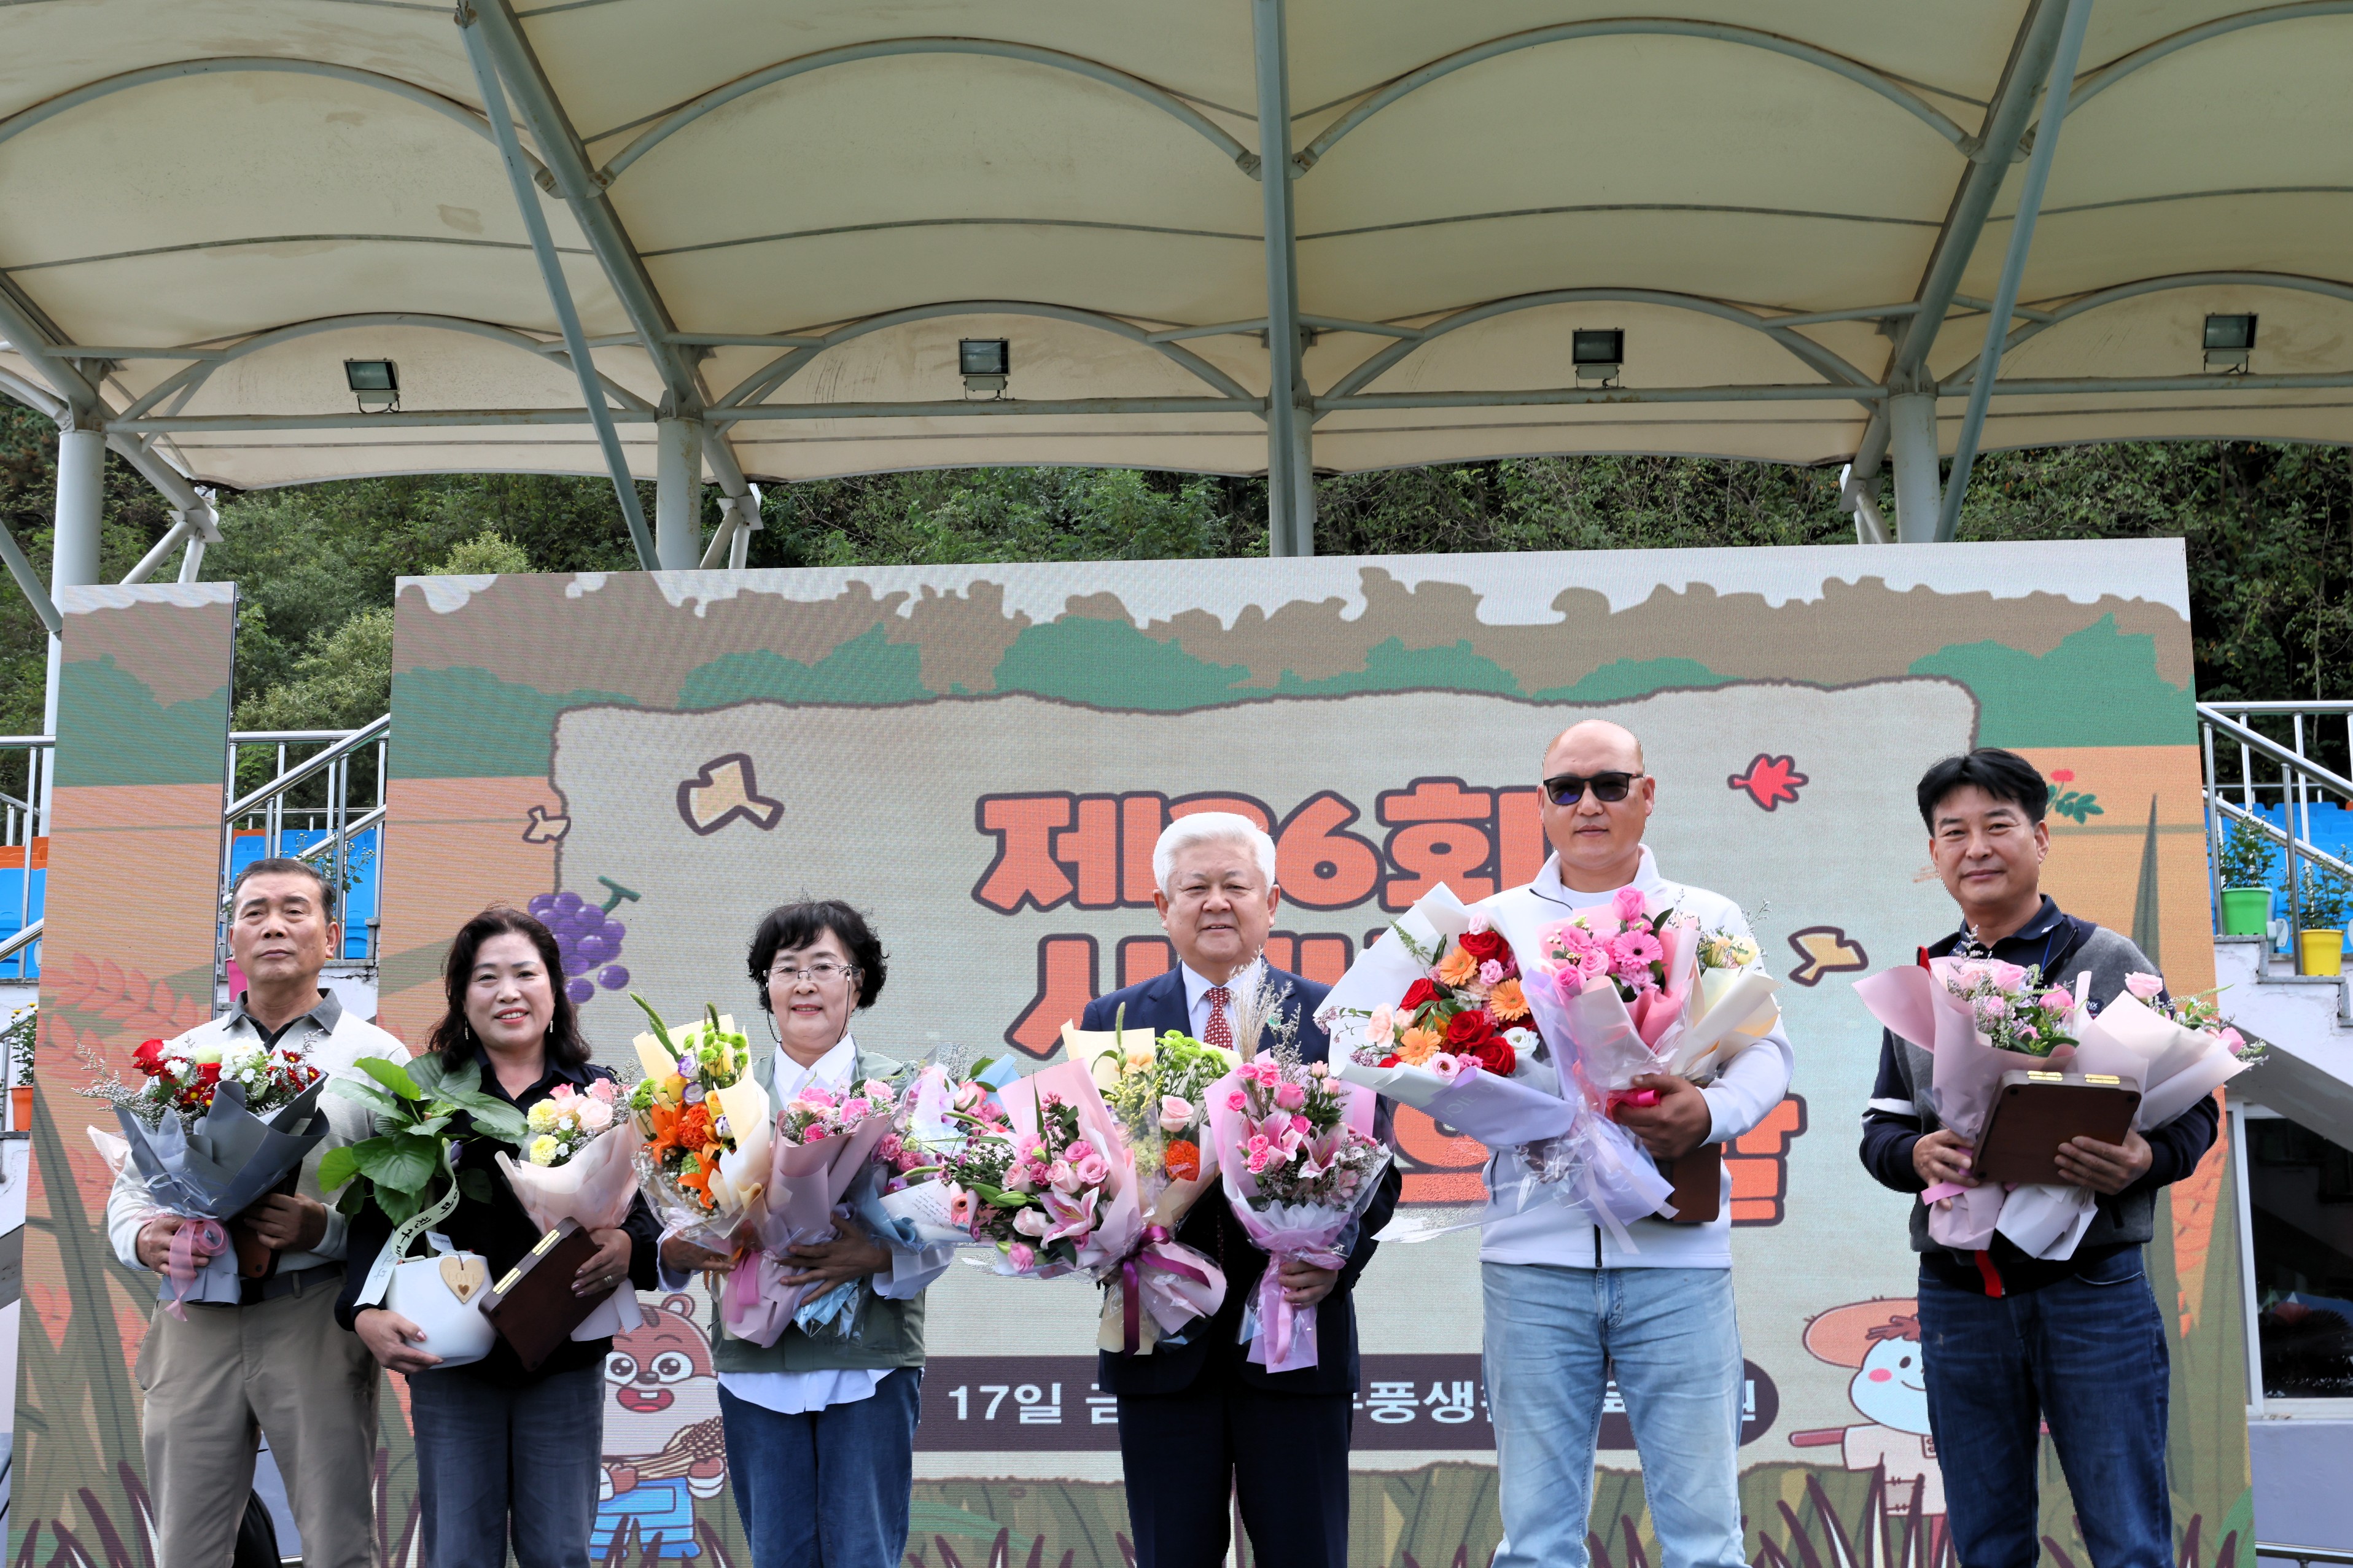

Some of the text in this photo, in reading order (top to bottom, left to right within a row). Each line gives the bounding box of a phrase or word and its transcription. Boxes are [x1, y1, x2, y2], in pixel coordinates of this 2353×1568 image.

[971, 776, 1552, 916] 제6회
[448, 1271, 482, 1284] LOVE
[948, 1382, 1062, 1424] 17일
